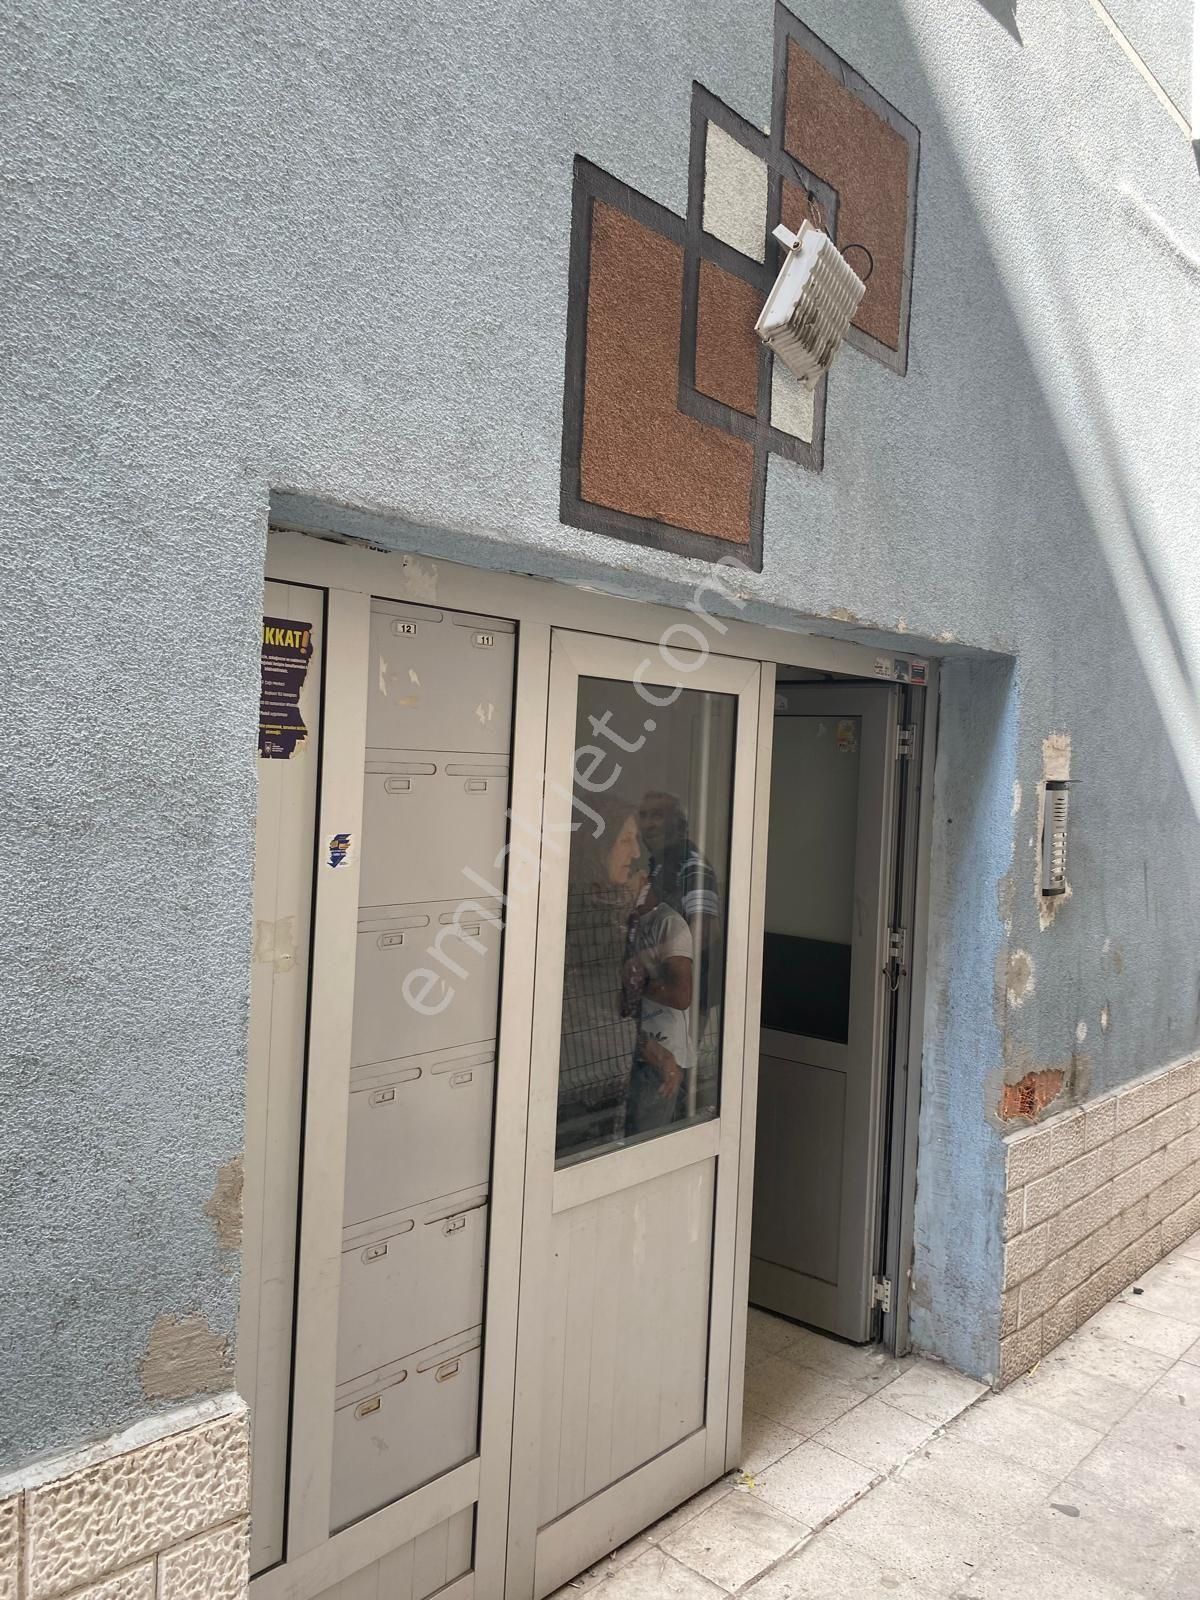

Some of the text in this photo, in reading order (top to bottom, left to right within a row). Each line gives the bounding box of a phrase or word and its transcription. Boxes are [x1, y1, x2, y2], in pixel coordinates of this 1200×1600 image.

[401, 624, 412, 633] 12
[263, 626, 310, 655] KKAT!
[481, 635, 490, 645] 11
